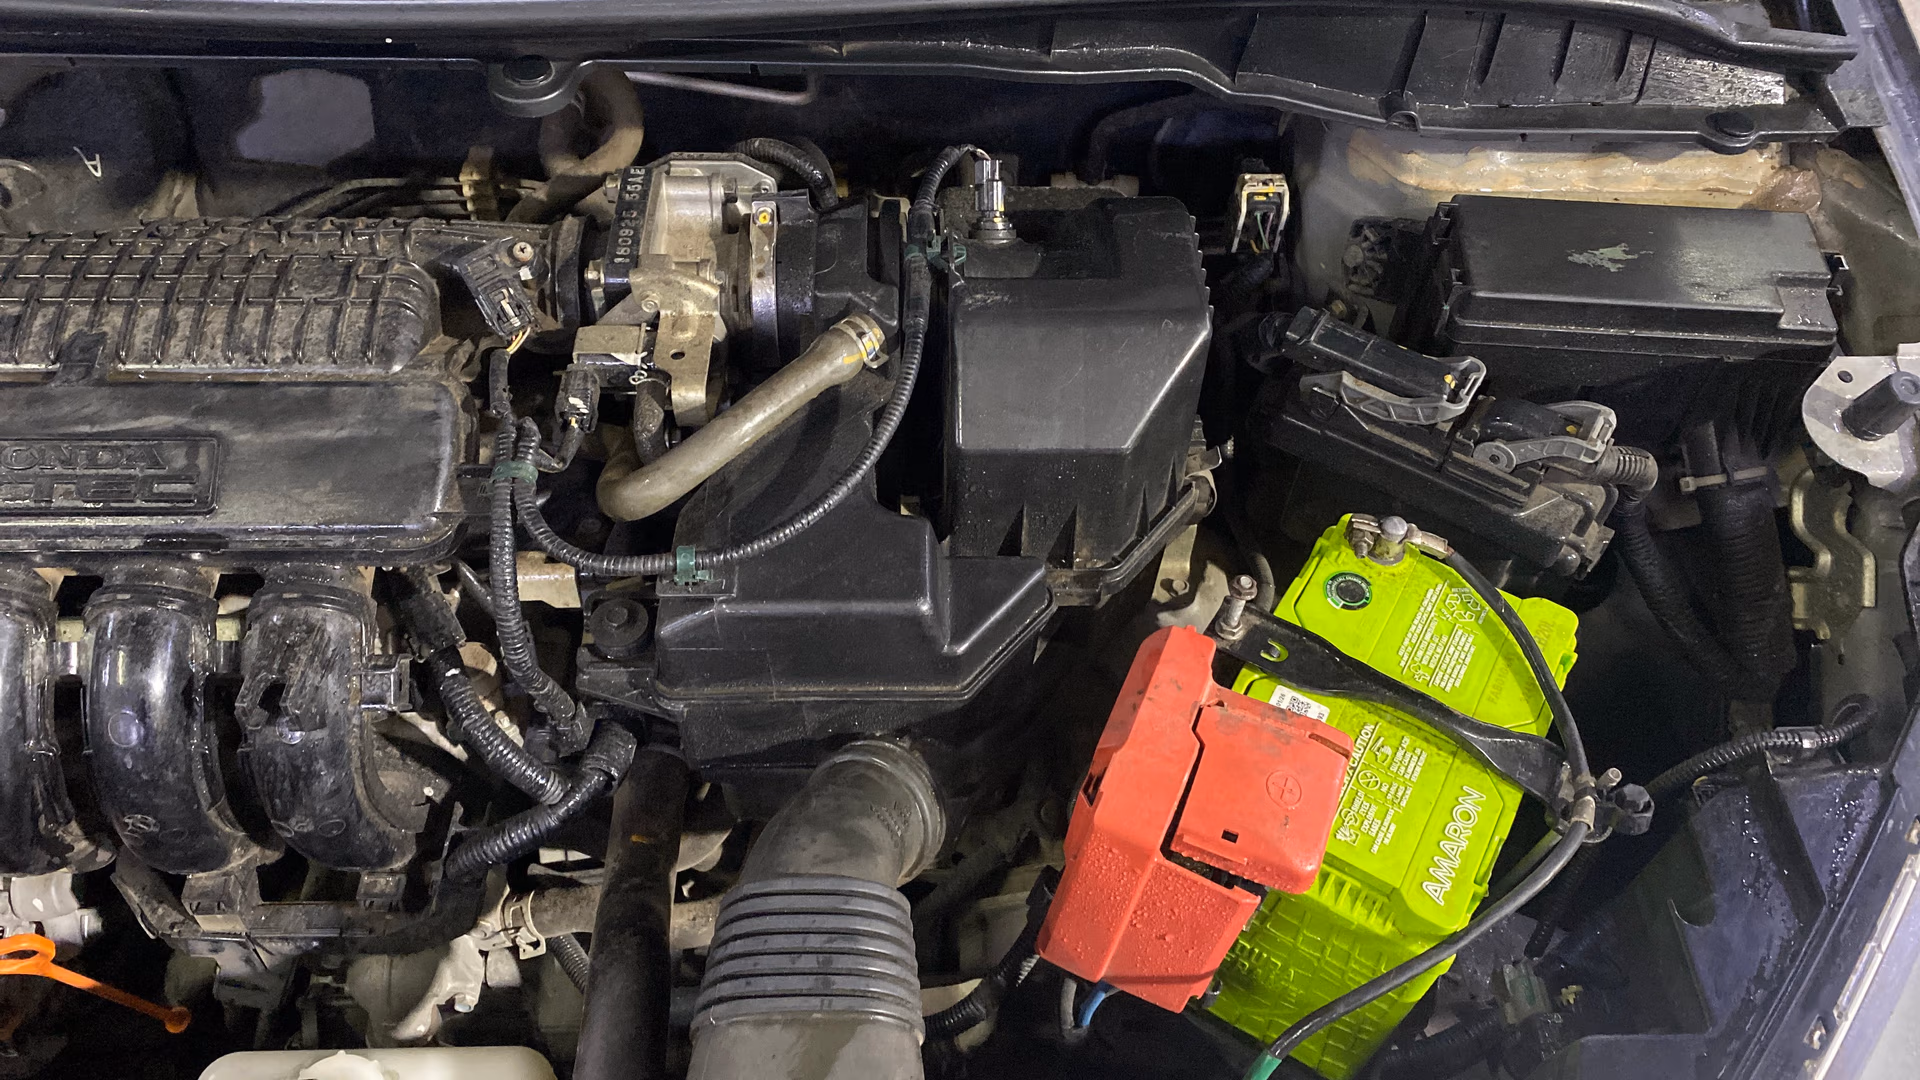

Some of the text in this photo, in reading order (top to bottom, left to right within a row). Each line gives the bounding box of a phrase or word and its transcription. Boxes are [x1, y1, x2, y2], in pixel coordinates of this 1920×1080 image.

[0, 446, 168, 470] ONDA
[0, 474, 197, 504] TEC
[1349, 723, 1376, 768] CAUTION
[1380, 782, 1389, 793] NO
[1422, 785, 1487, 906] AMARON
